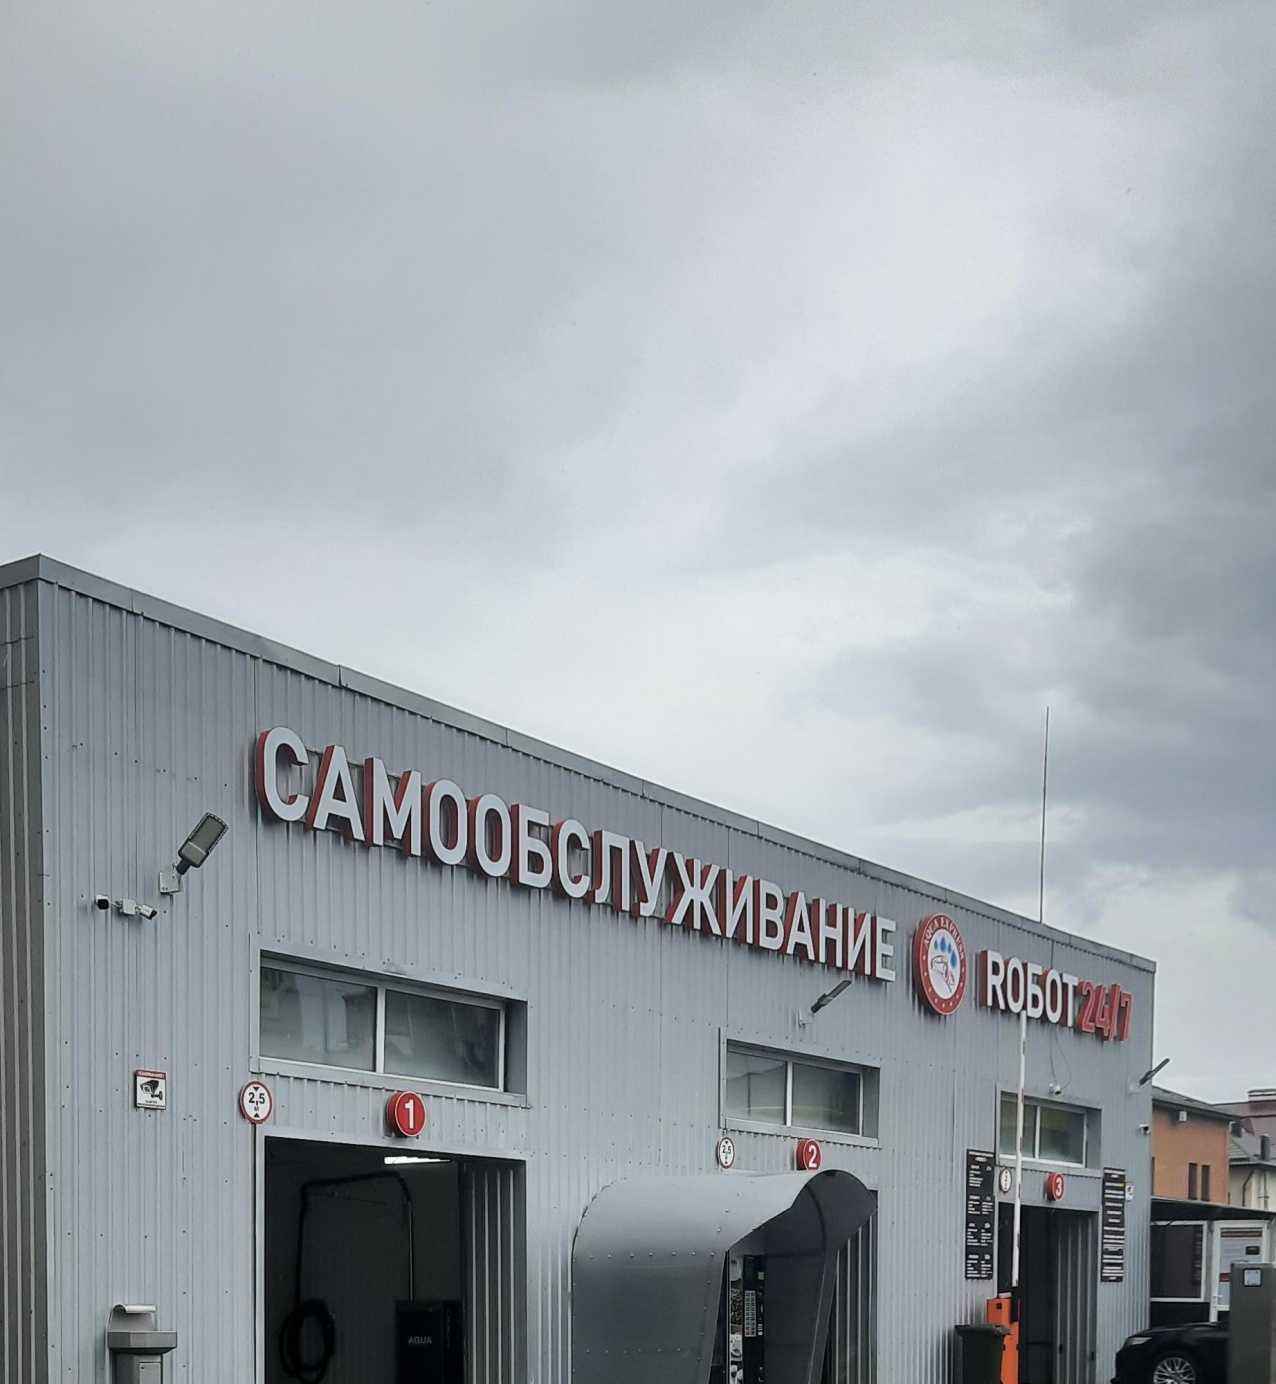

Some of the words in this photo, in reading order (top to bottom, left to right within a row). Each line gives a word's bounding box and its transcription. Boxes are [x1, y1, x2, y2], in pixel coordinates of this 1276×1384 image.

[257, 726, 896, 982] САМООБСЛУЖИВАНИЕ
[1080, 980, 1134, 1041] 24/7
[404, 1099, 415, 1130] 1
[808, 1144, 818, 1168] 2
[1055, 1176, 1063, 1199] 3
